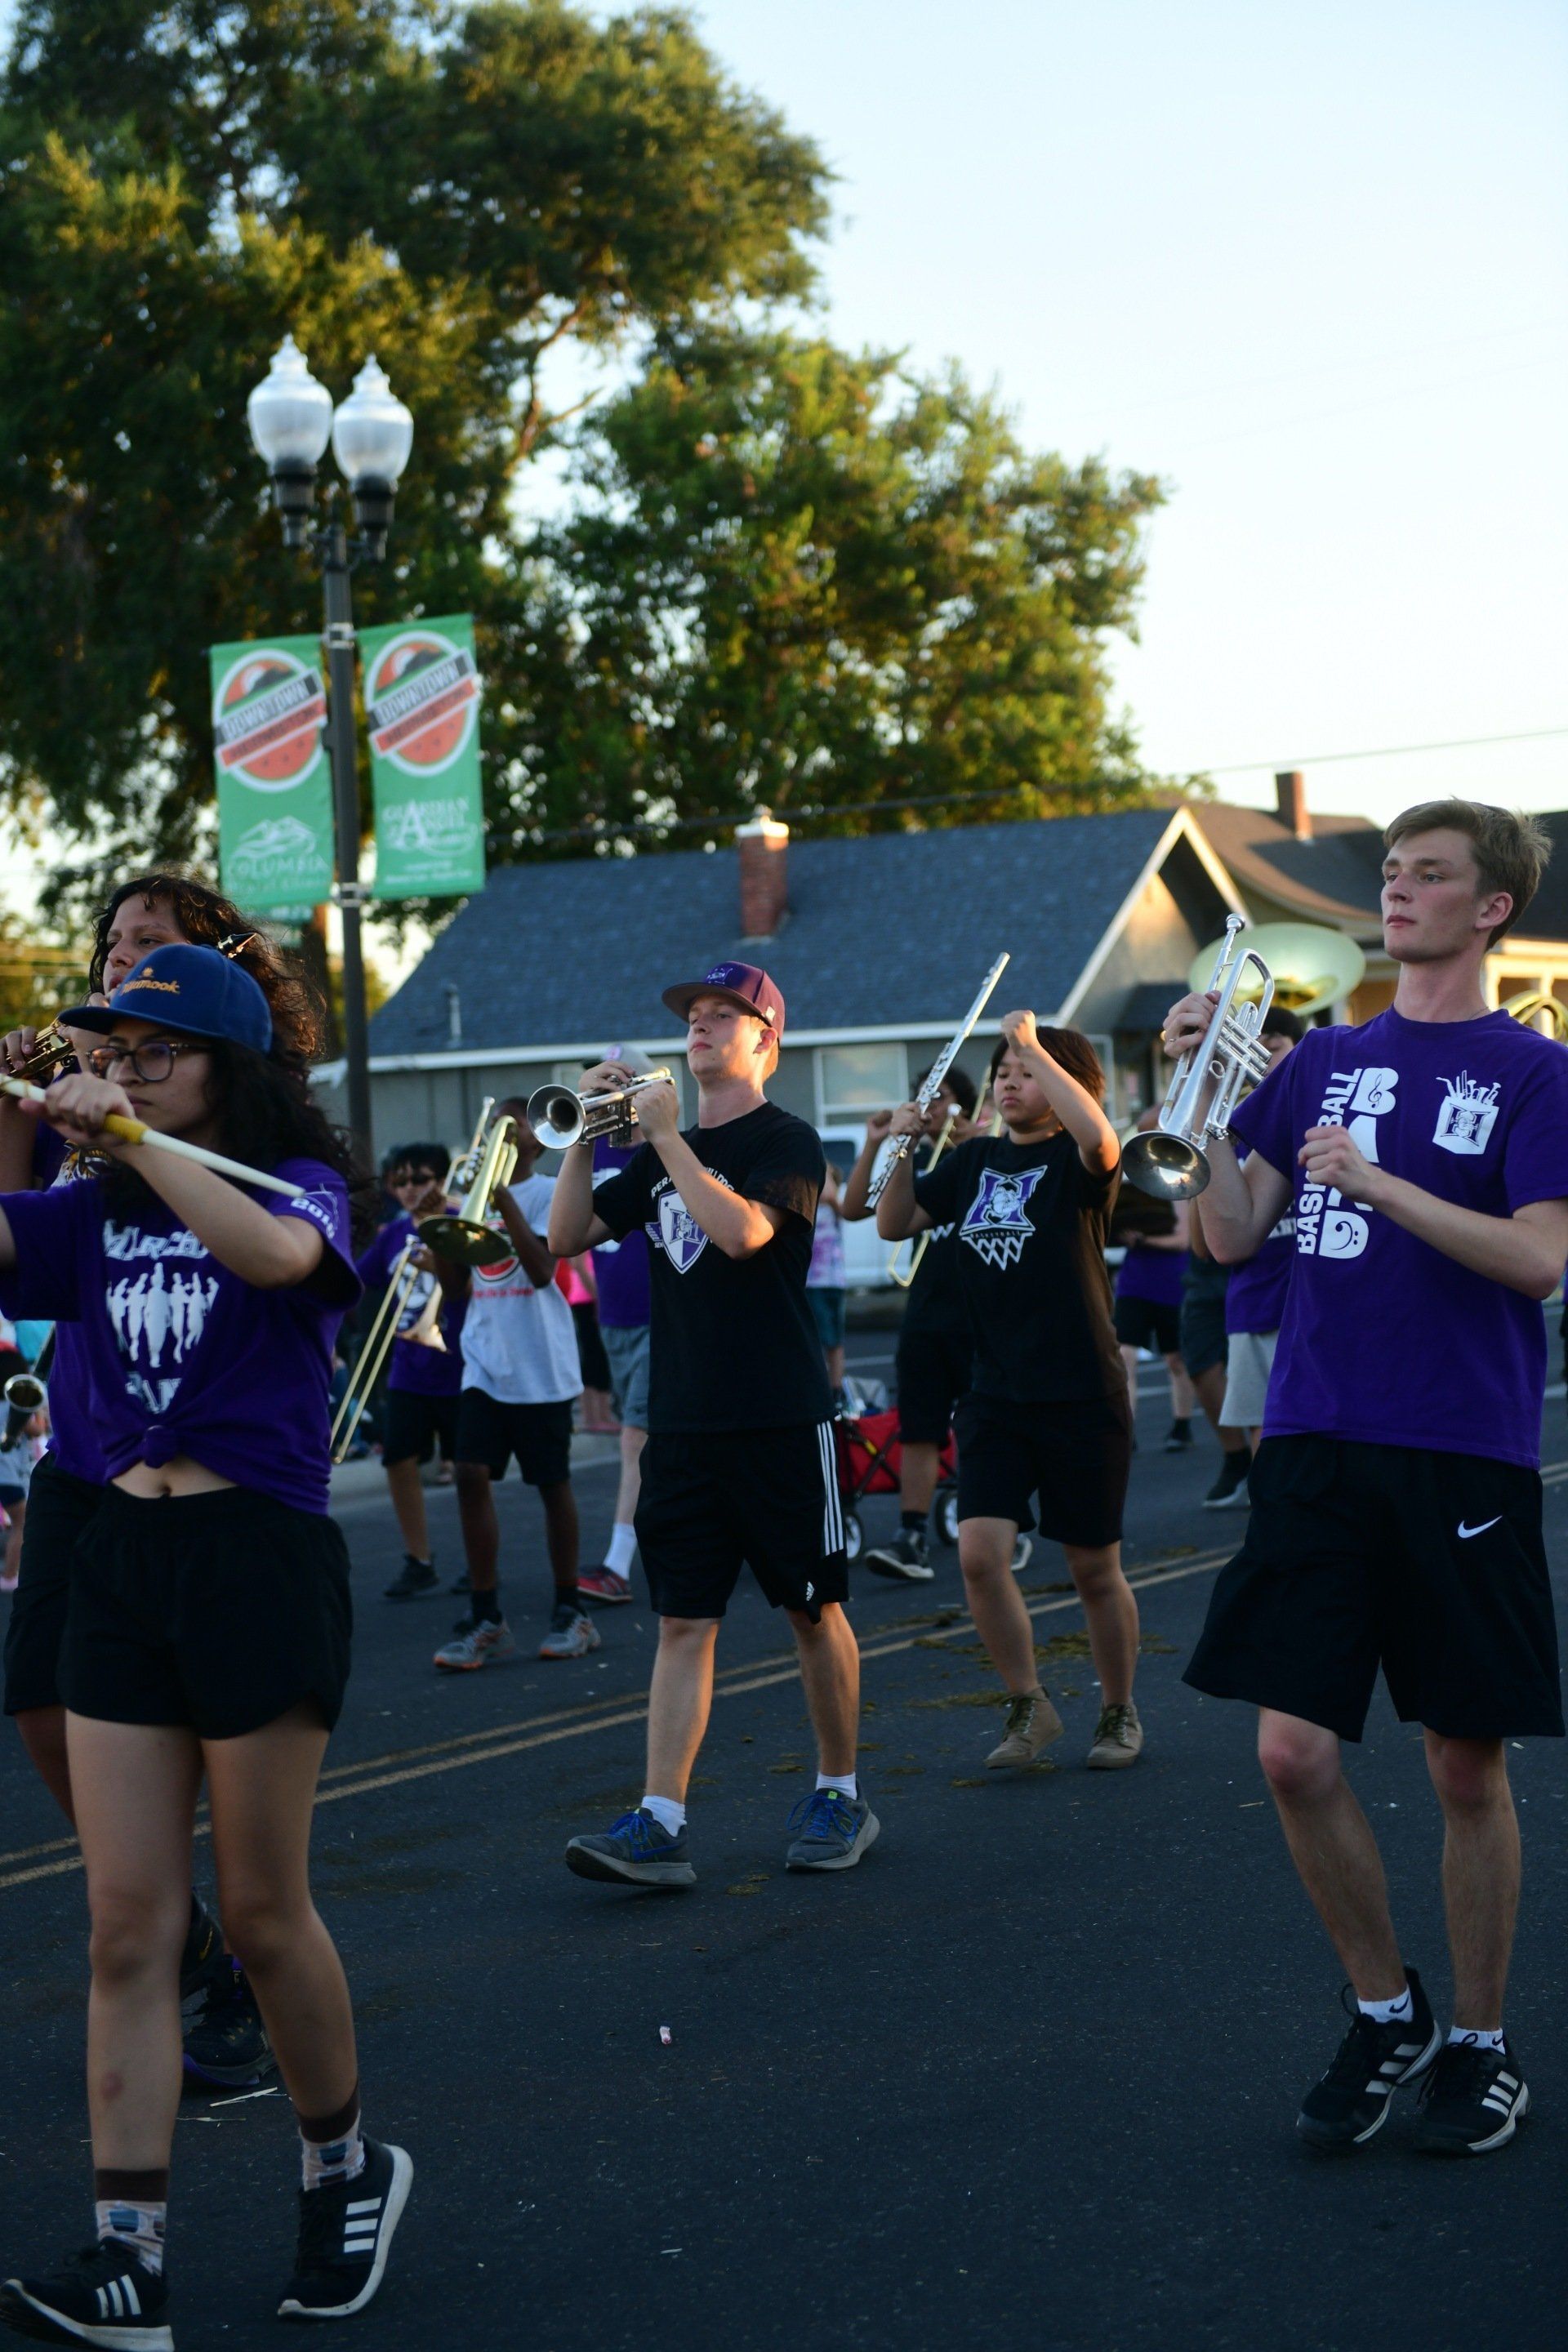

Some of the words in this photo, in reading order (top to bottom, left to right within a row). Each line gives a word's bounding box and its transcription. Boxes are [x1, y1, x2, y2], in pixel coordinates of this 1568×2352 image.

[220, 678, 310, 744] DOWNTOWN
[376, 658, 460, 726] DOWNTOWN
[1297, 1067, 1363, 1255] BASBALL
